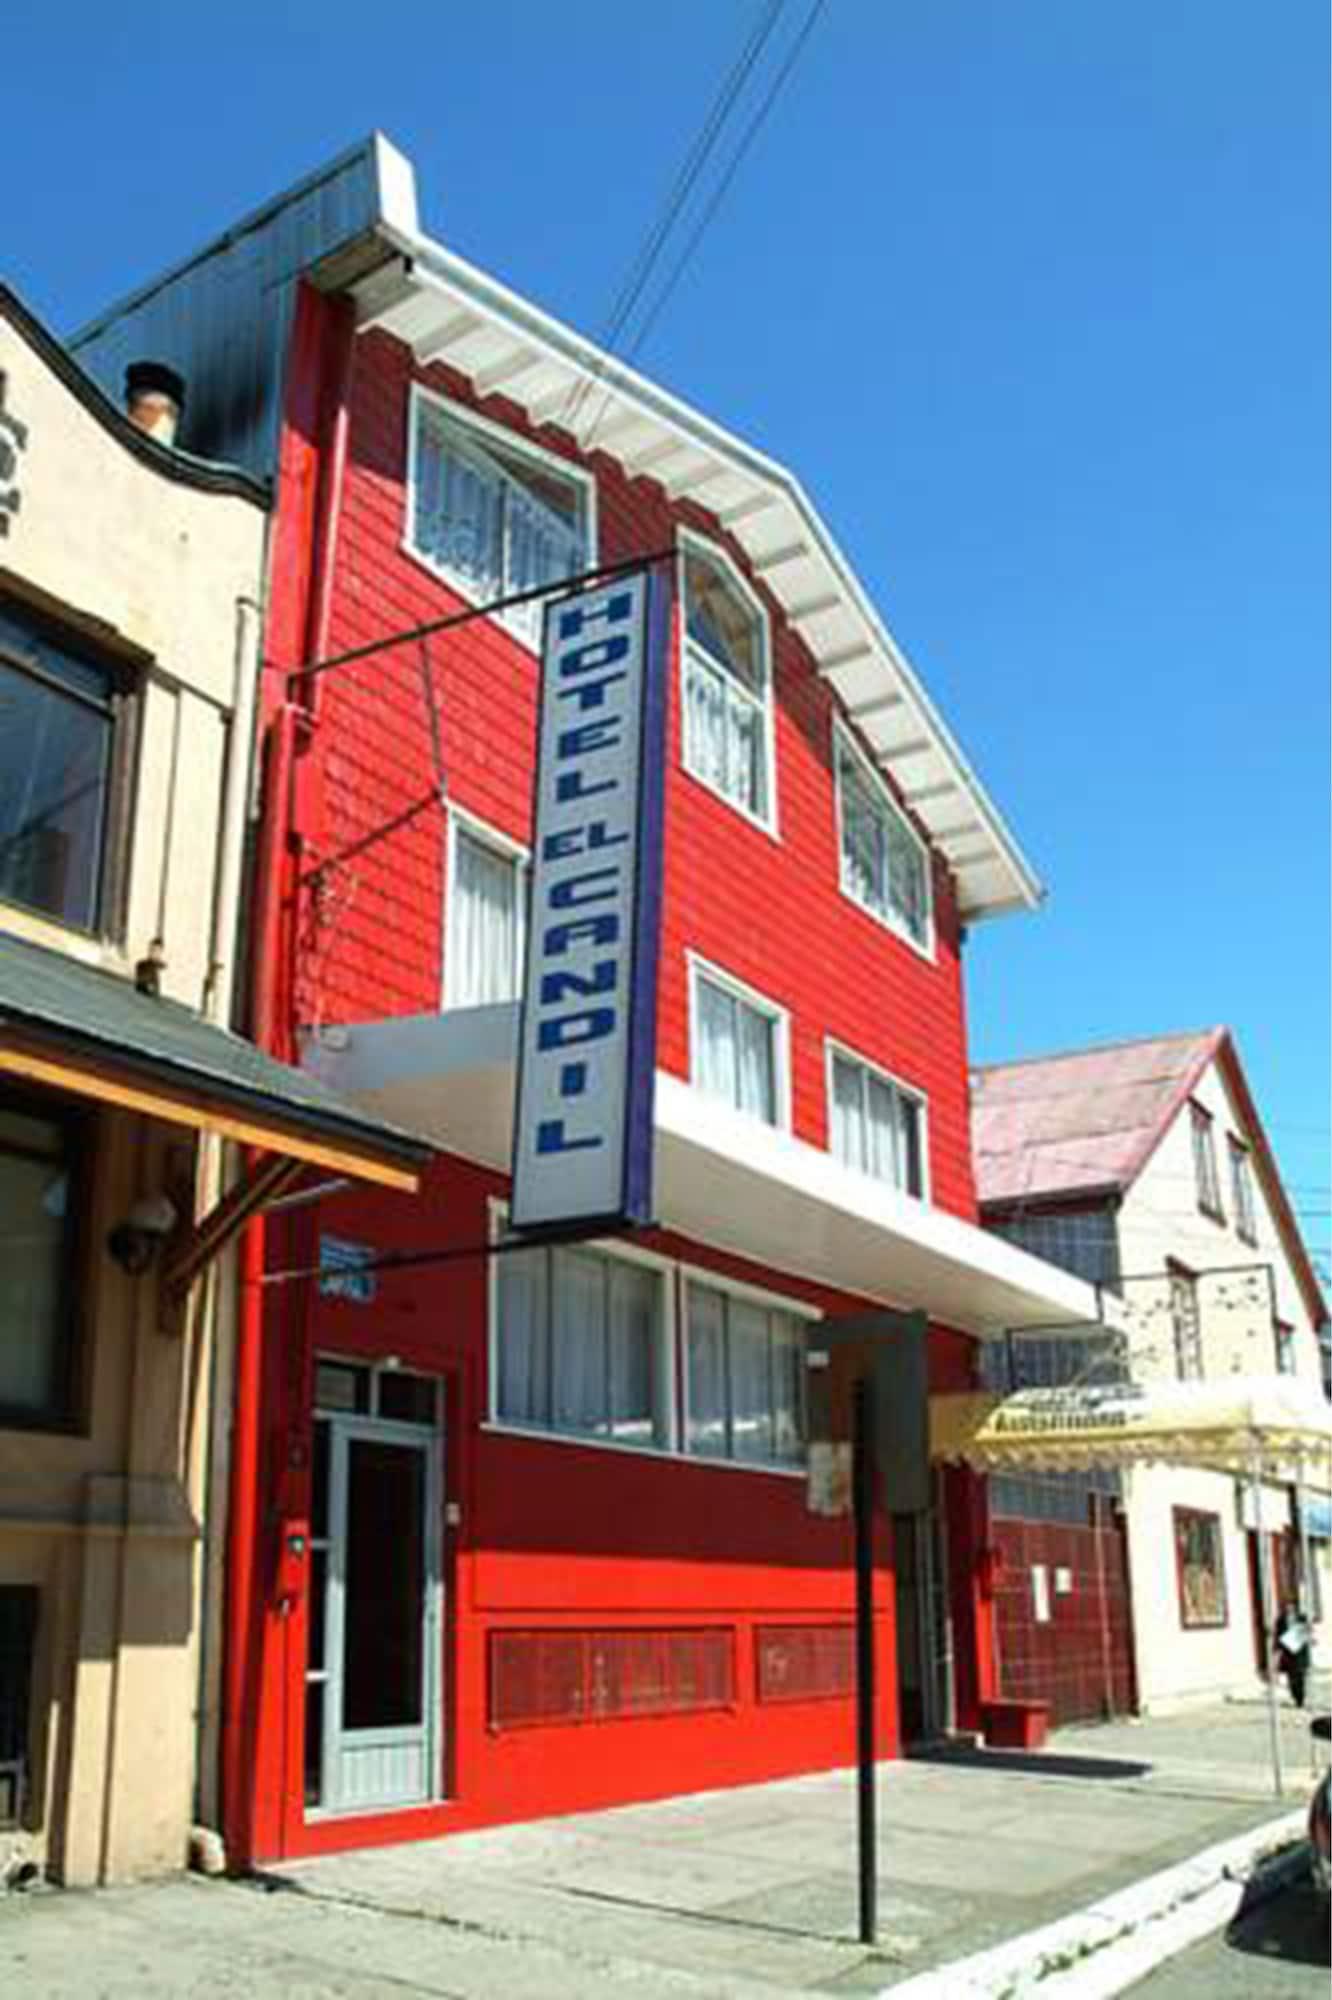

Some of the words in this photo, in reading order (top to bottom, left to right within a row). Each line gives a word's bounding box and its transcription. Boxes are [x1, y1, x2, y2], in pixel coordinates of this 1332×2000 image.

[556, 592, 632, 803] HOTEL
[542, 819, 630, 860] EL
[535, 867, 621, 1156] CANDIL
